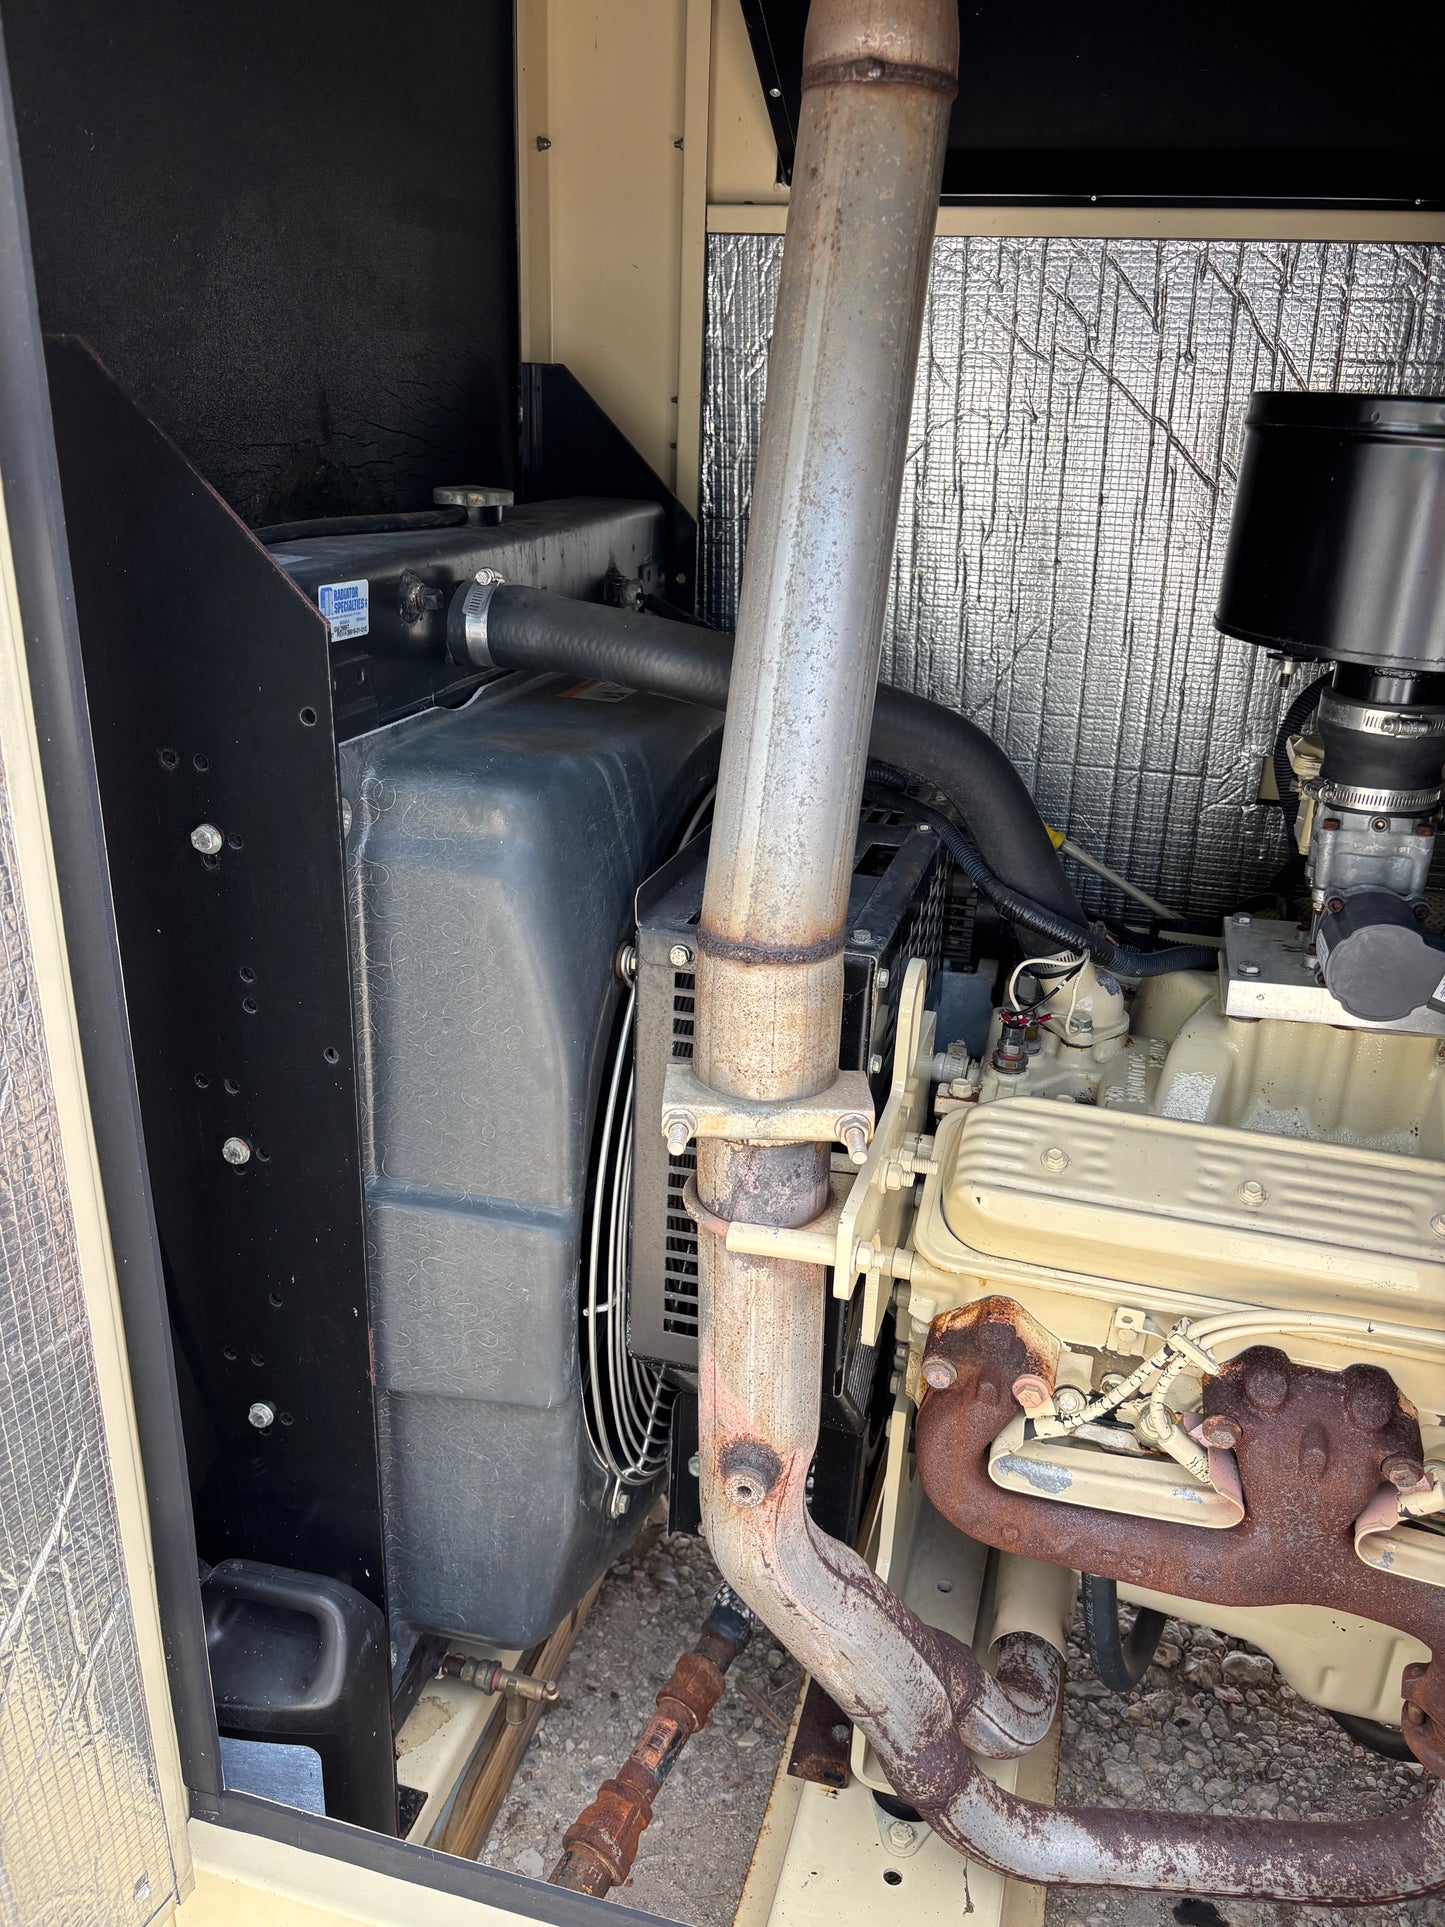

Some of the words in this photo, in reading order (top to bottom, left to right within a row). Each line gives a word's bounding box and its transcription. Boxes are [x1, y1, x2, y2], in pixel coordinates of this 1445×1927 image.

[334, 586, 359, 601] RADIATOR
[334, 598, 365, 614] SPECIALTIES
[1085, 1589, 1093, 1598] IN
[1086, 1600, 1095, 1626] MADE
